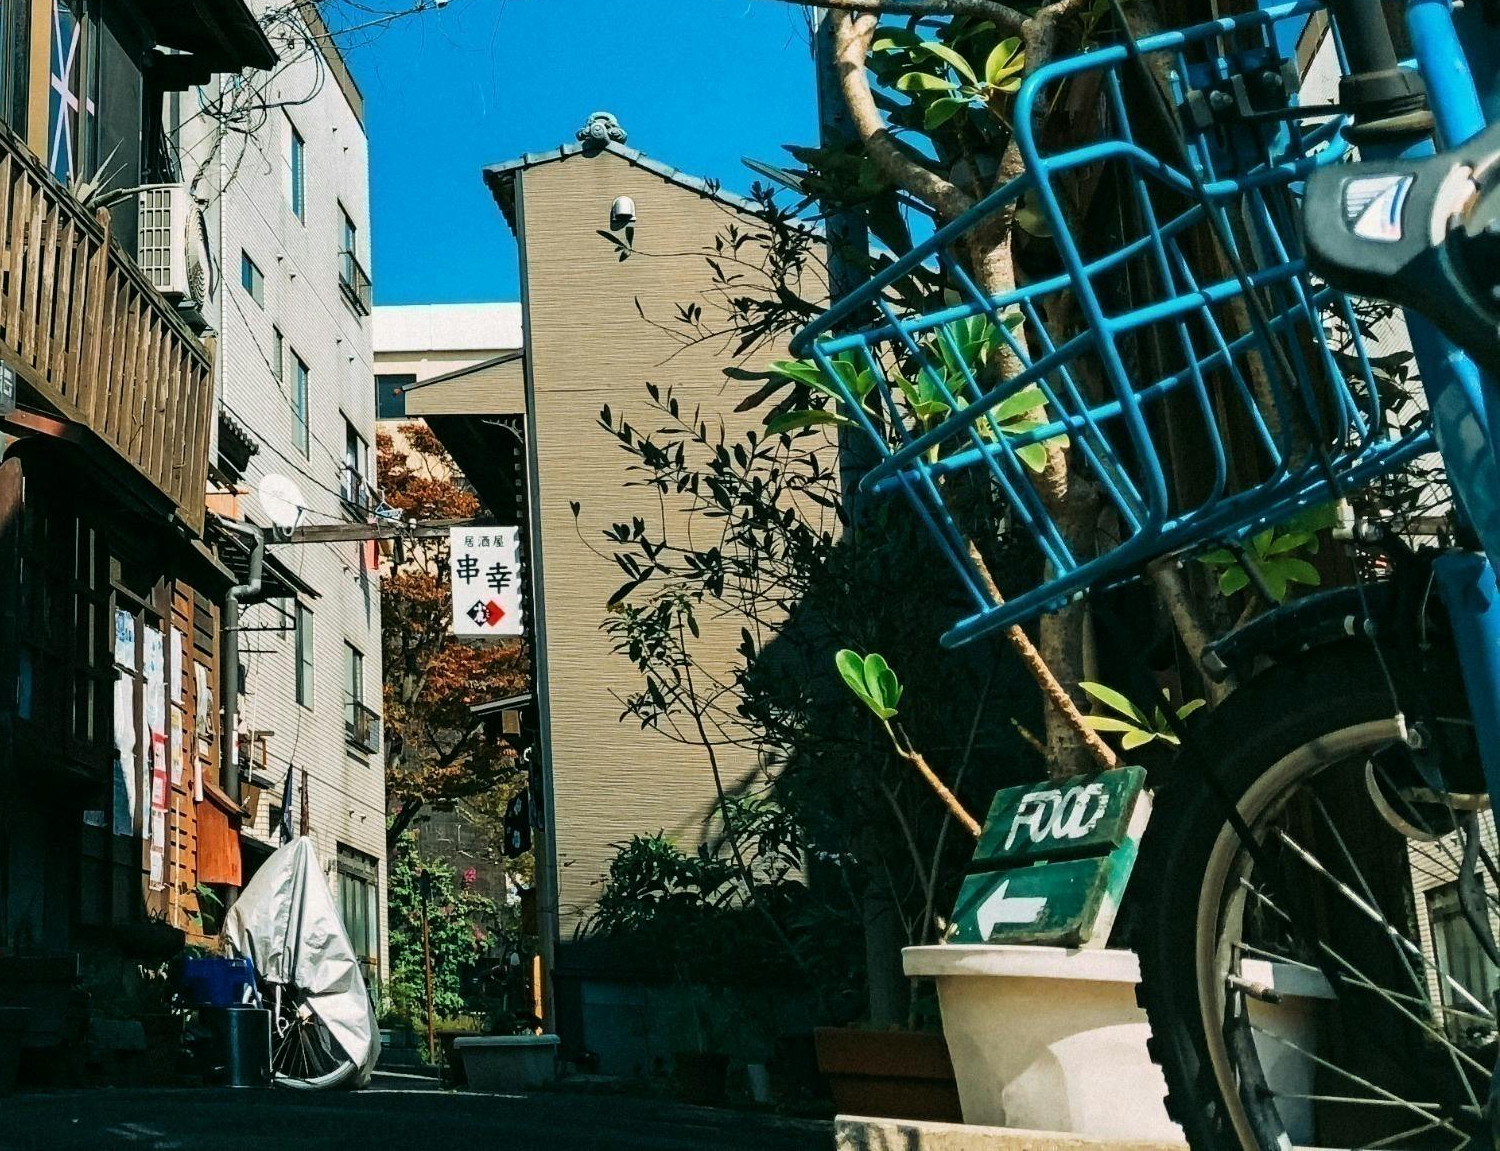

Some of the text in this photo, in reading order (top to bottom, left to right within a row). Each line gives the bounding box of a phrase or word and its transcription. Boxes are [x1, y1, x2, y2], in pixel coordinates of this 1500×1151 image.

[463, 535, 505, 548] 居酒屋
[456, 553, 513, 595] 串幸
[1004, 783, 1110, 851] FOOD
